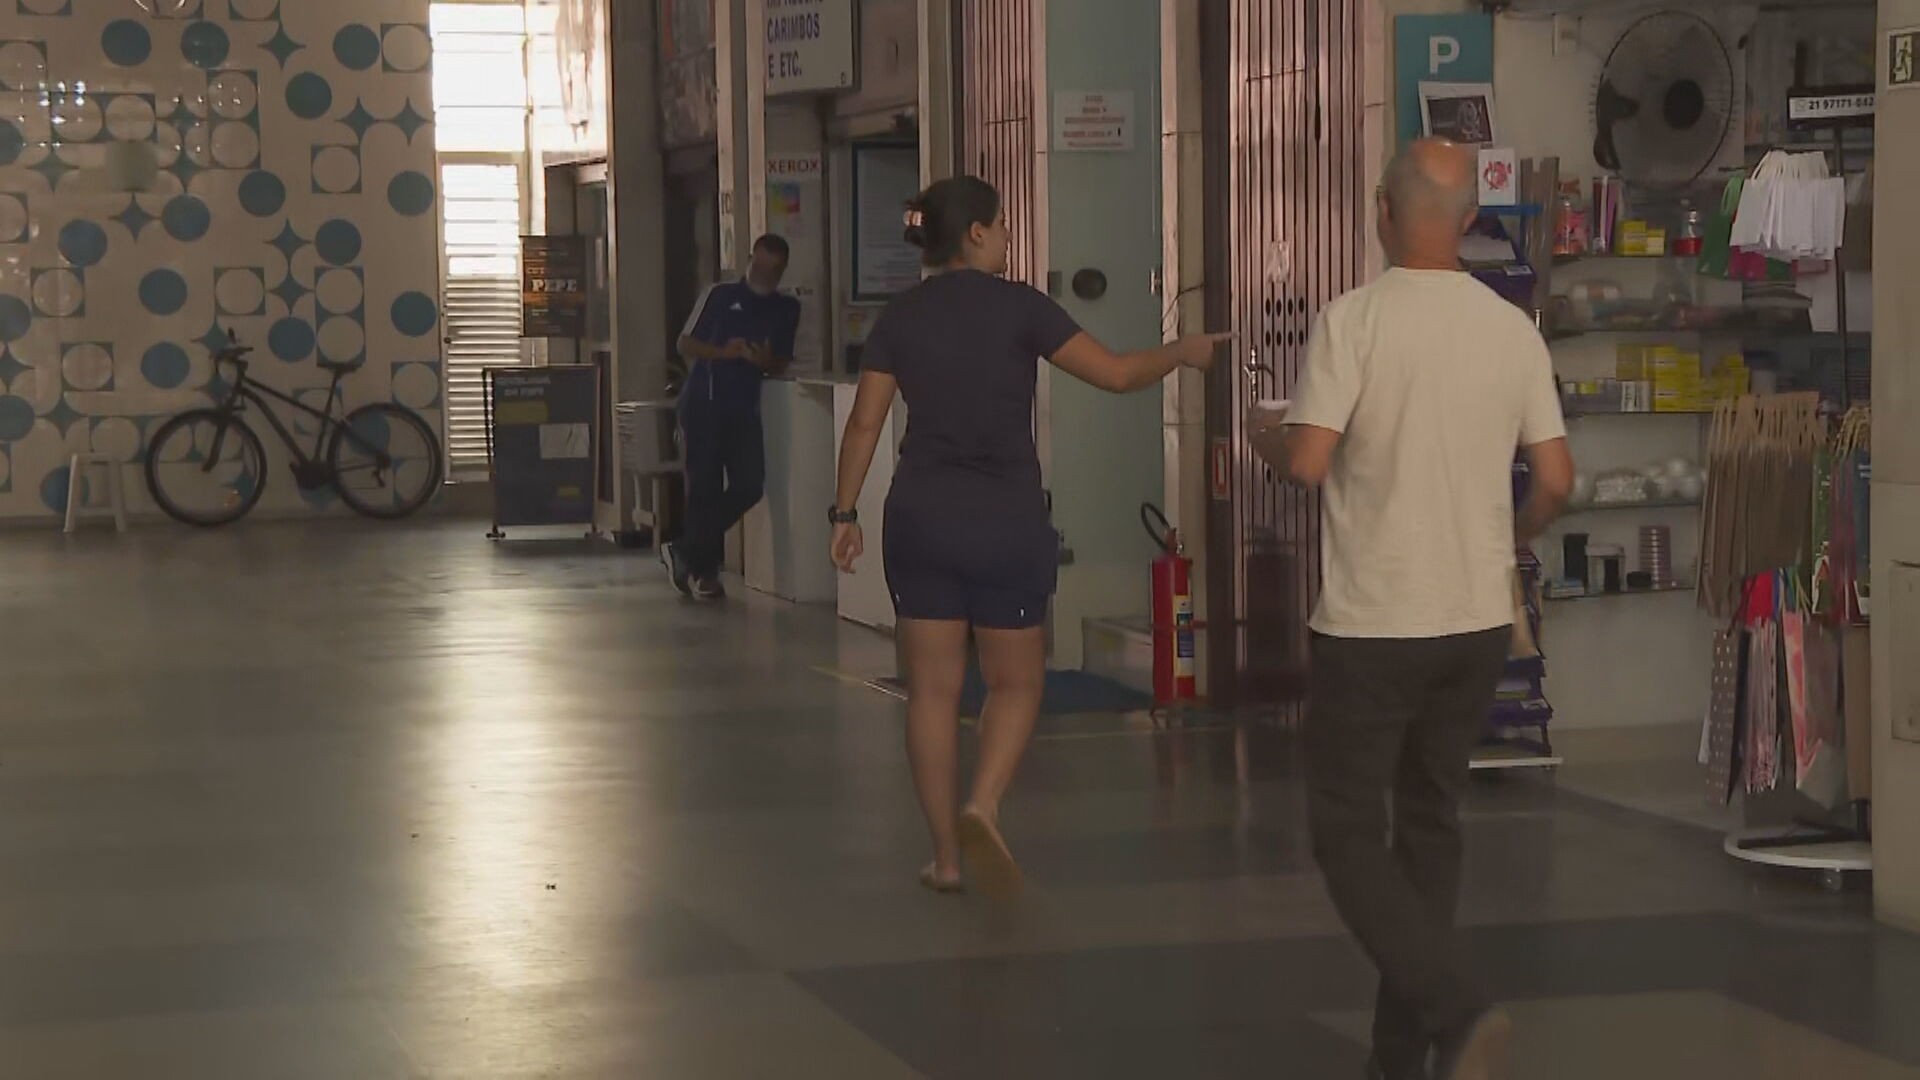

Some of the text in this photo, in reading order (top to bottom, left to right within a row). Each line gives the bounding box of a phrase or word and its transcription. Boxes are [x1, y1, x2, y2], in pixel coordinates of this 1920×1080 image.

[767, 13, 820, 43] CARIMBOS
[768, 50, 802, 78] E ETC.
[1429, 36, 1460, 74] P
[1808, 100, 1820, 110] 21
[768, 159, 819, 173] XEROX
[532, 279, 577, 293] PEPE
